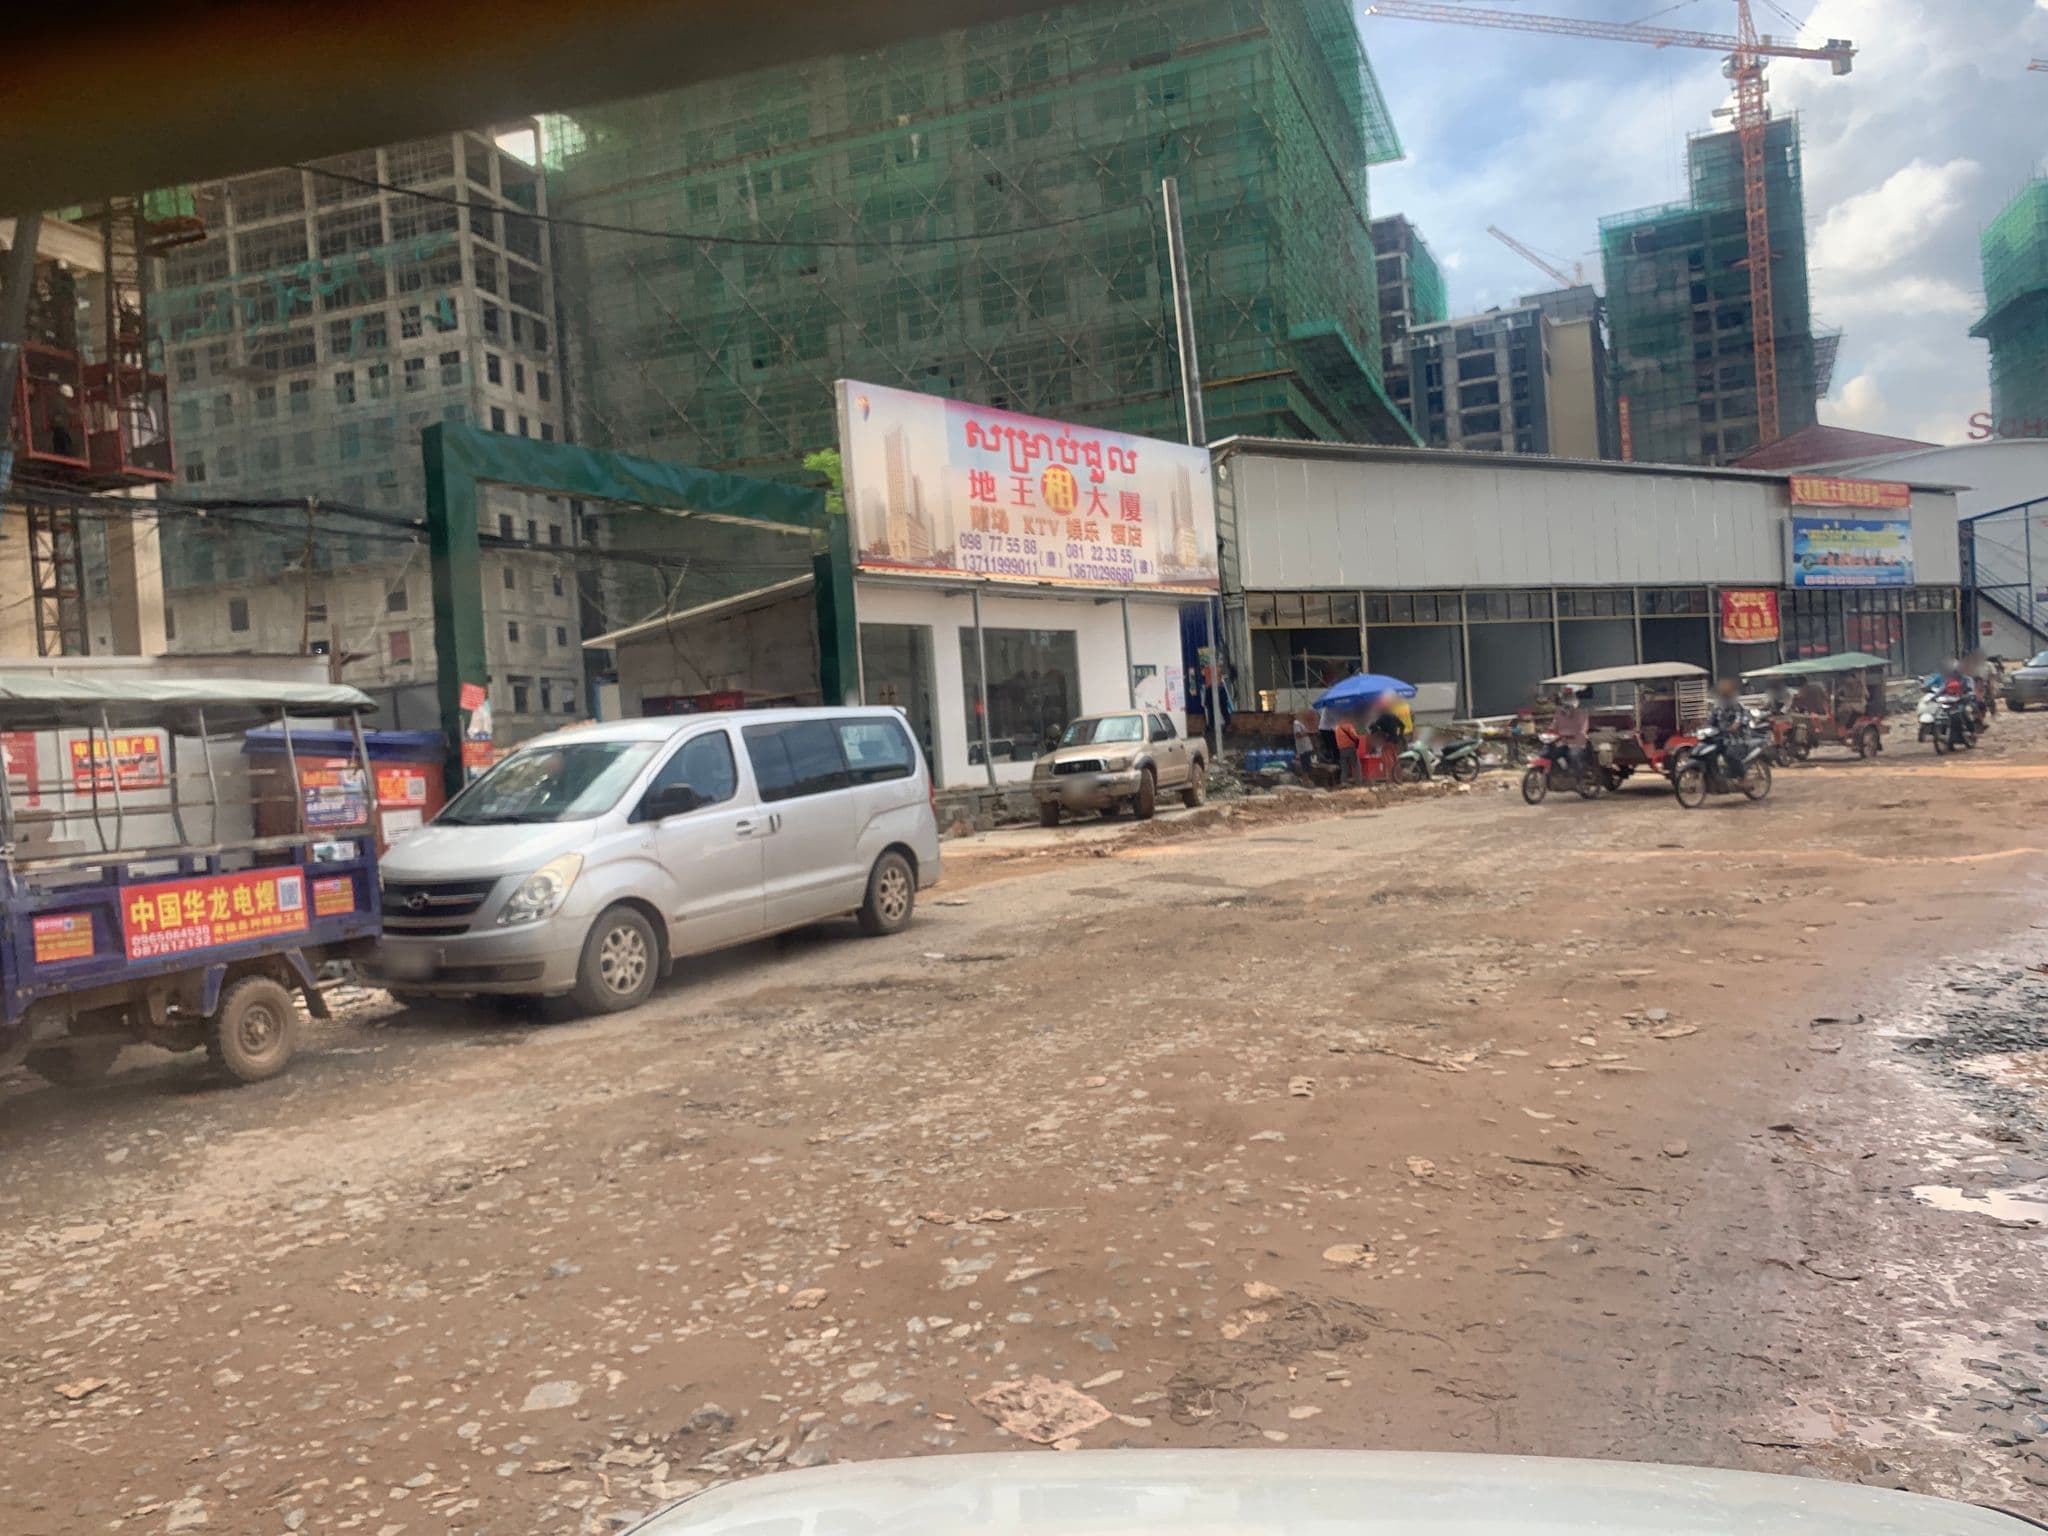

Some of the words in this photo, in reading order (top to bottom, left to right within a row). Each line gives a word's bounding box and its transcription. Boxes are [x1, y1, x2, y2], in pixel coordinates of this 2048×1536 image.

[1023, 516, 1060, 537] KTV
[1066, 517, 1100, 543] 娱乐
[960, 532, 982, 551] 098
[989, 535, 1003, 553] 77
[1006, 537, 1020, 554] 55
[1023, 538, 1037, 555] 88
[1065, 542, 1084, 560] 081
[1090, 545, 1103, 562] 22
[1105, 547, 1118, 563] 33
[1120, 548, 1133, 565] 55
[130, 879, 277, 932] 中国华龙电焊
